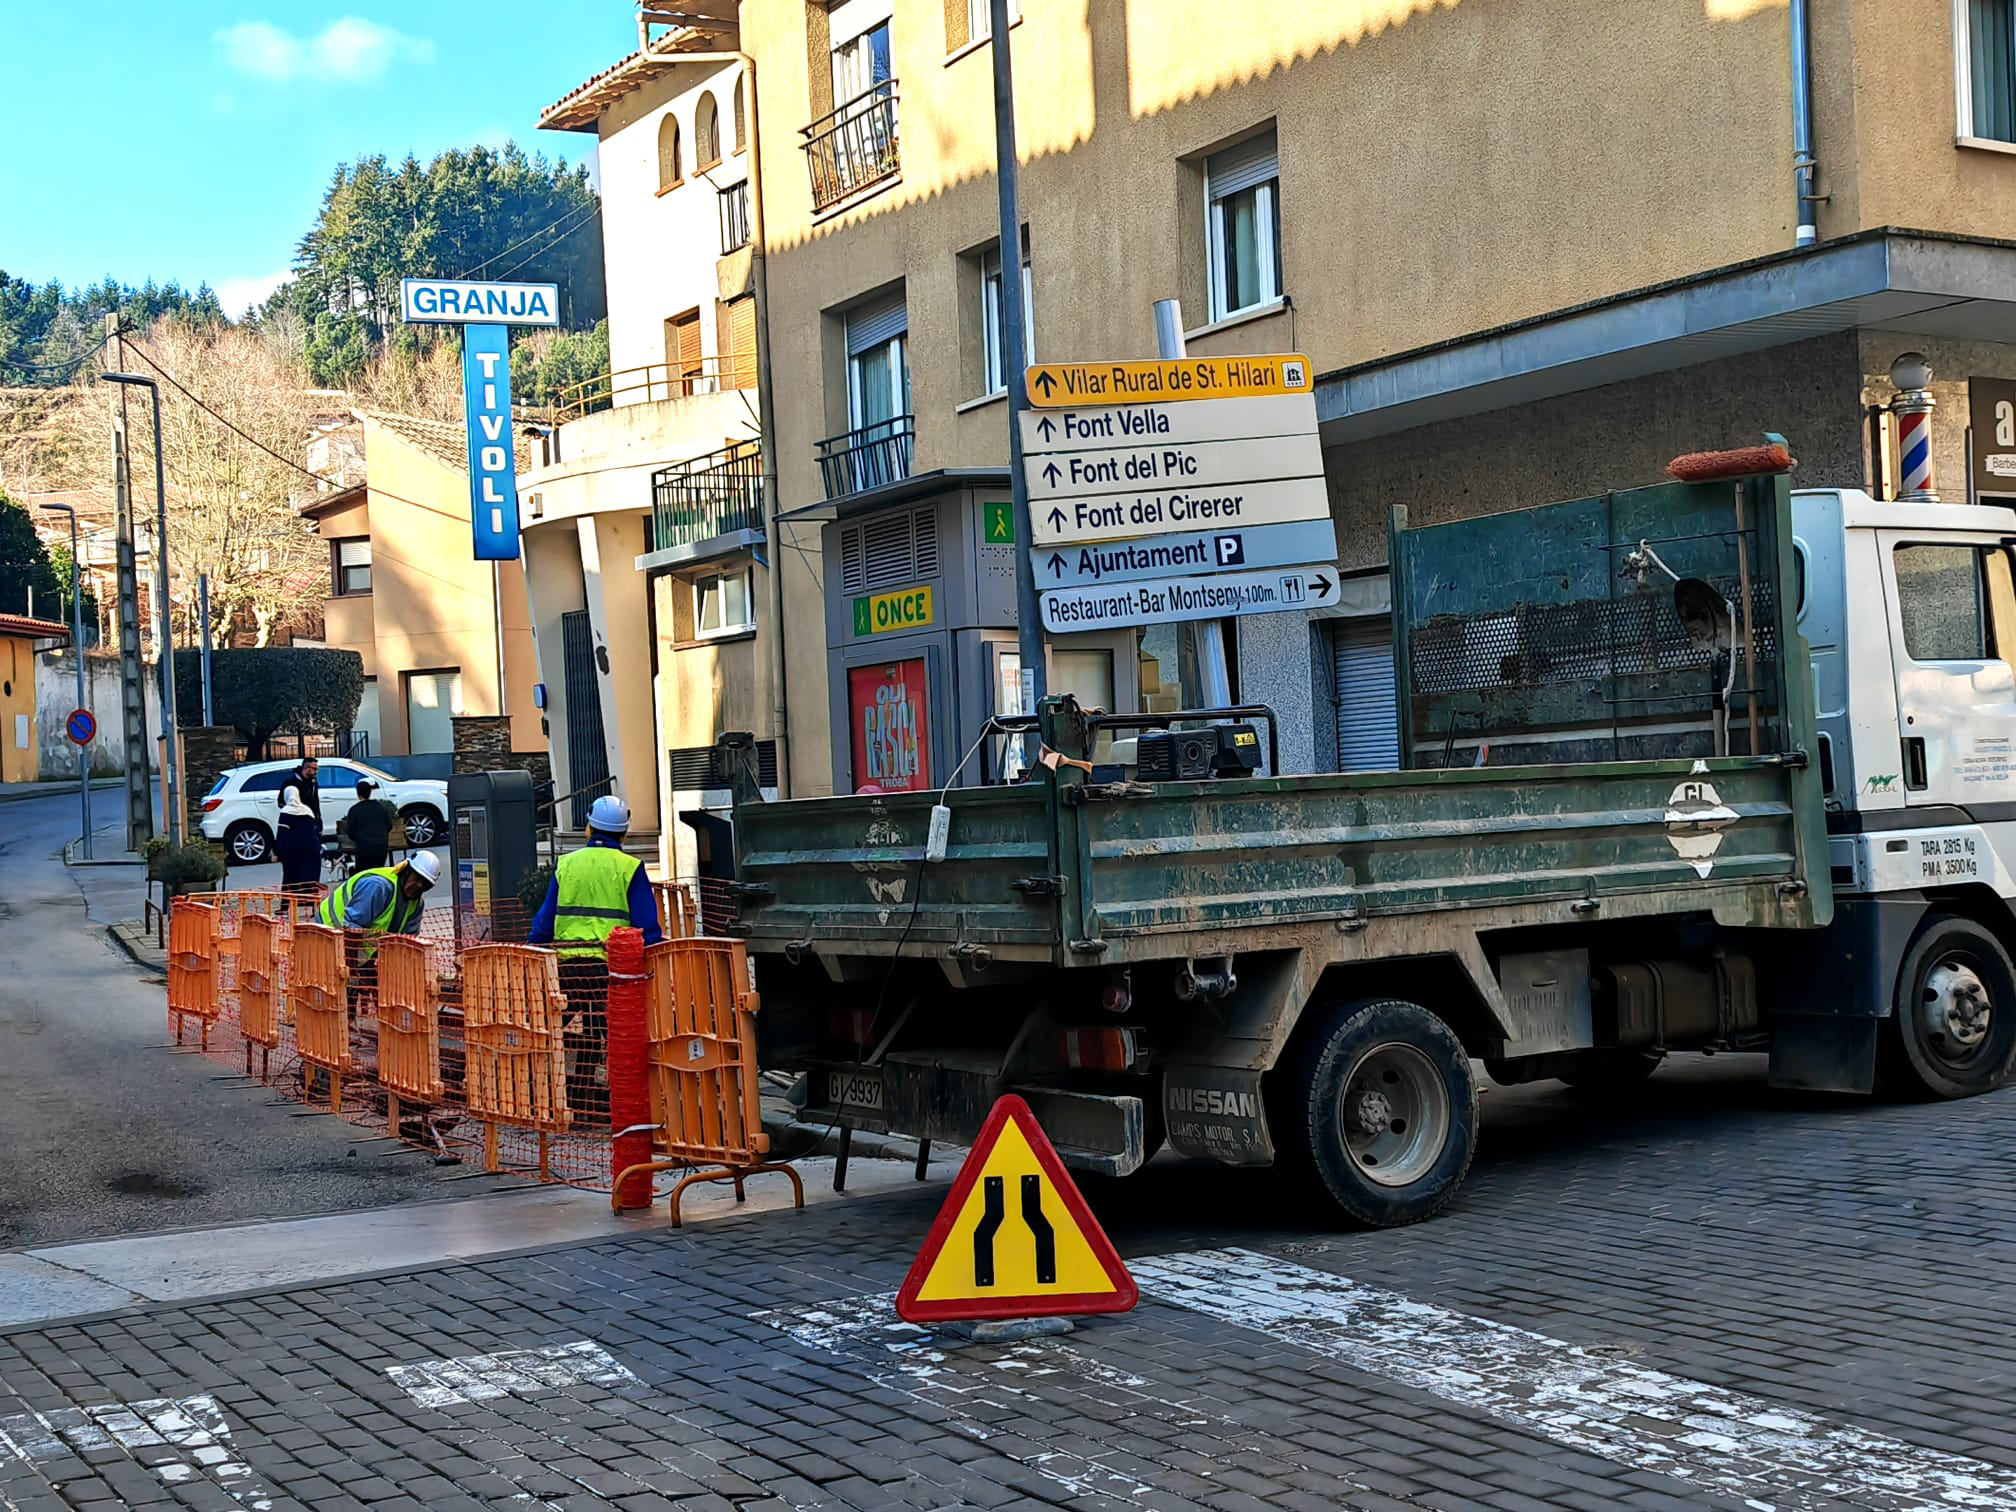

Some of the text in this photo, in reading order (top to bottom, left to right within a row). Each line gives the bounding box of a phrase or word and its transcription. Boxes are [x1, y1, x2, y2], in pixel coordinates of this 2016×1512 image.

[413, 287, 549, 317] GRANJA
[1062, 361, 1275, 394] Vilar Rural de St. Hilari
[1064, 408, 1170, 439] Font Vella
[475, 352, 507, 533] TIVOLI
[1069, 451, 1197, 484] Font del Pic
[1992, 457, 2016, 469] Barbe
[1075, 495, 1243, 529] Font del Cirerer
[1078, 538, 1238, 579] Ajuntament P
[877, 593, 926, 626] ONCE
[1049, 584, 1278, 623] Restaurant-Bar Montseny 100m.
[1921, 837, 1975, 856] TARA 2815 Kg
[1922, 858, 1976, 877] PMA 3500 Kg
[1169, 1087, 1256, 1118] NISSAN
